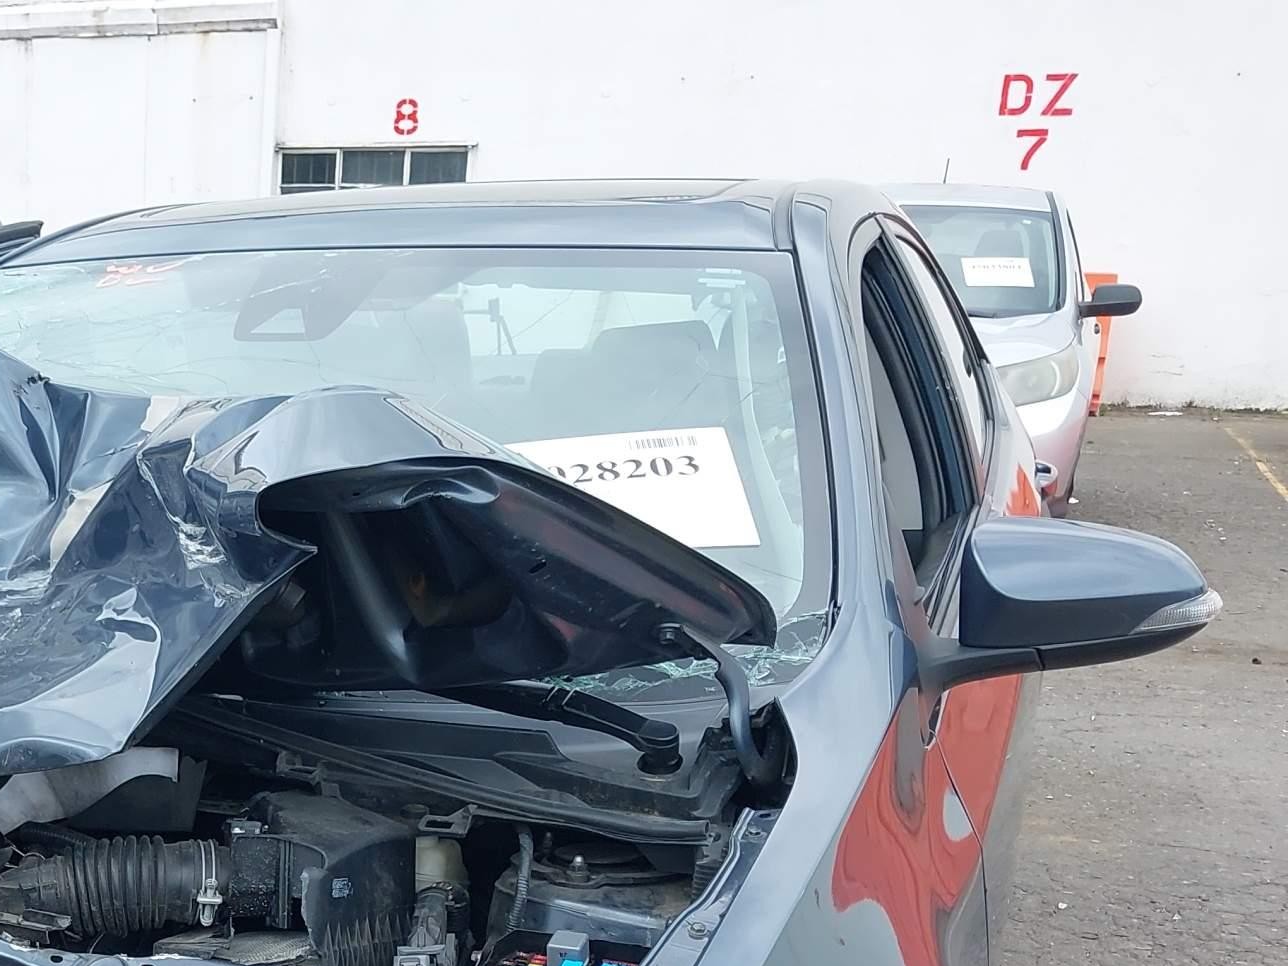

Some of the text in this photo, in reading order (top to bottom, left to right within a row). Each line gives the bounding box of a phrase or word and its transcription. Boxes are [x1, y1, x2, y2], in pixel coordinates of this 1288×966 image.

[998, 73, 1079, 116] DZ
[393, 98, 419, 136] 8
[1016, 129, 1049, 170] 7
